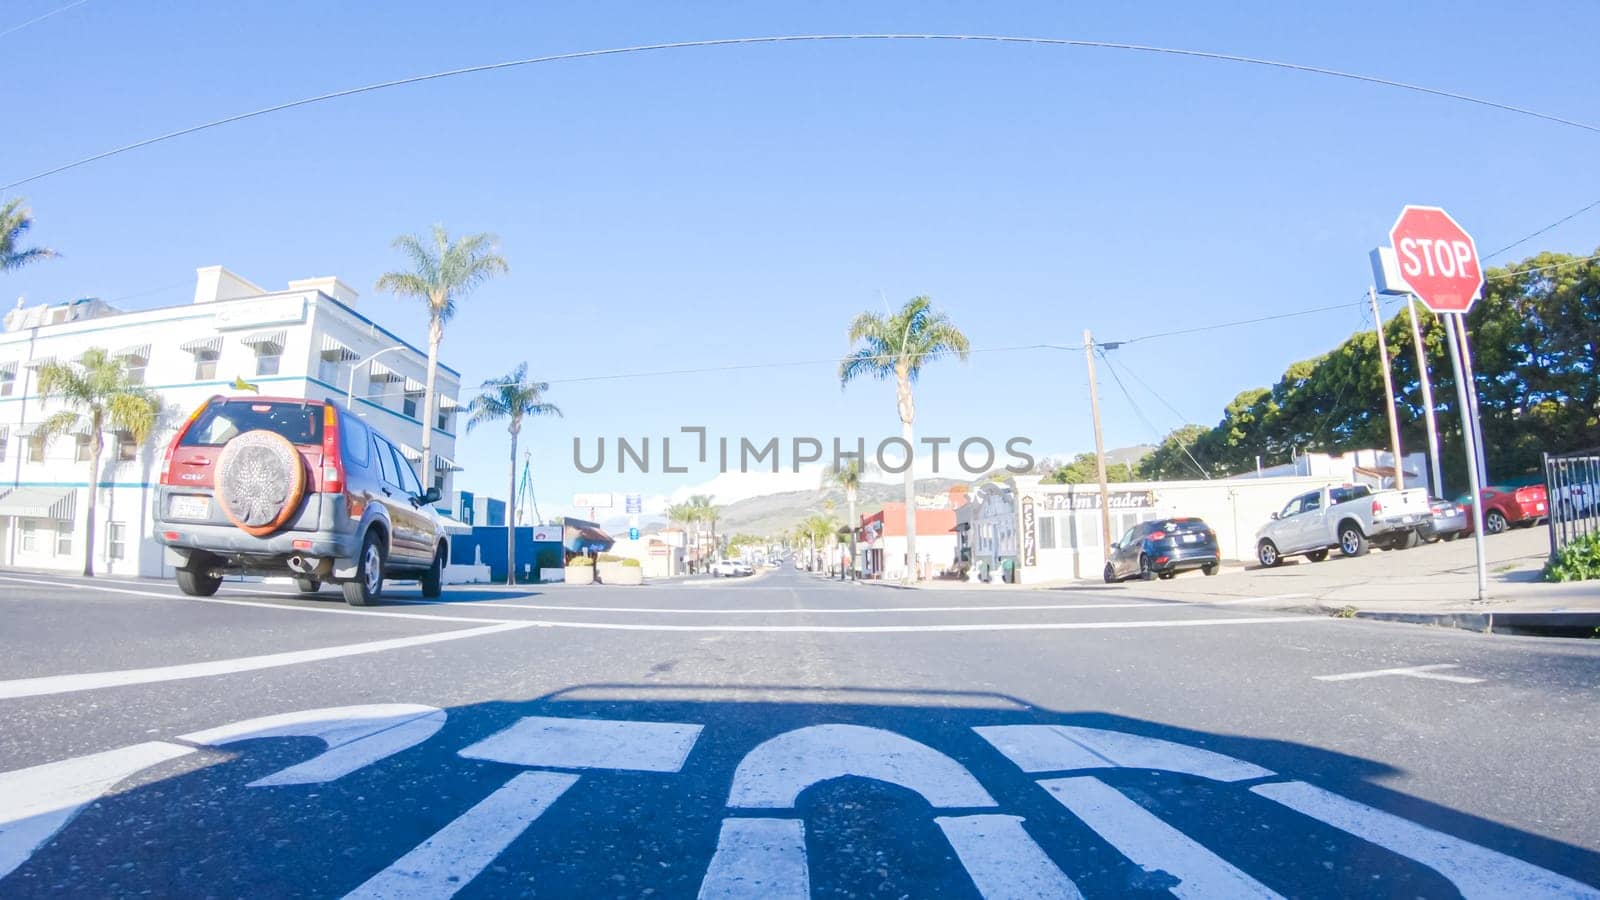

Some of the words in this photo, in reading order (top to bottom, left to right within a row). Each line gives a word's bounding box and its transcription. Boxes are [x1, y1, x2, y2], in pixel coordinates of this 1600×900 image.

[1400, 237, 1472, 278] STOP
[1053, 493, 1092, 510] Palm
[1024, 504, 1035, 566] PSYCHIC
